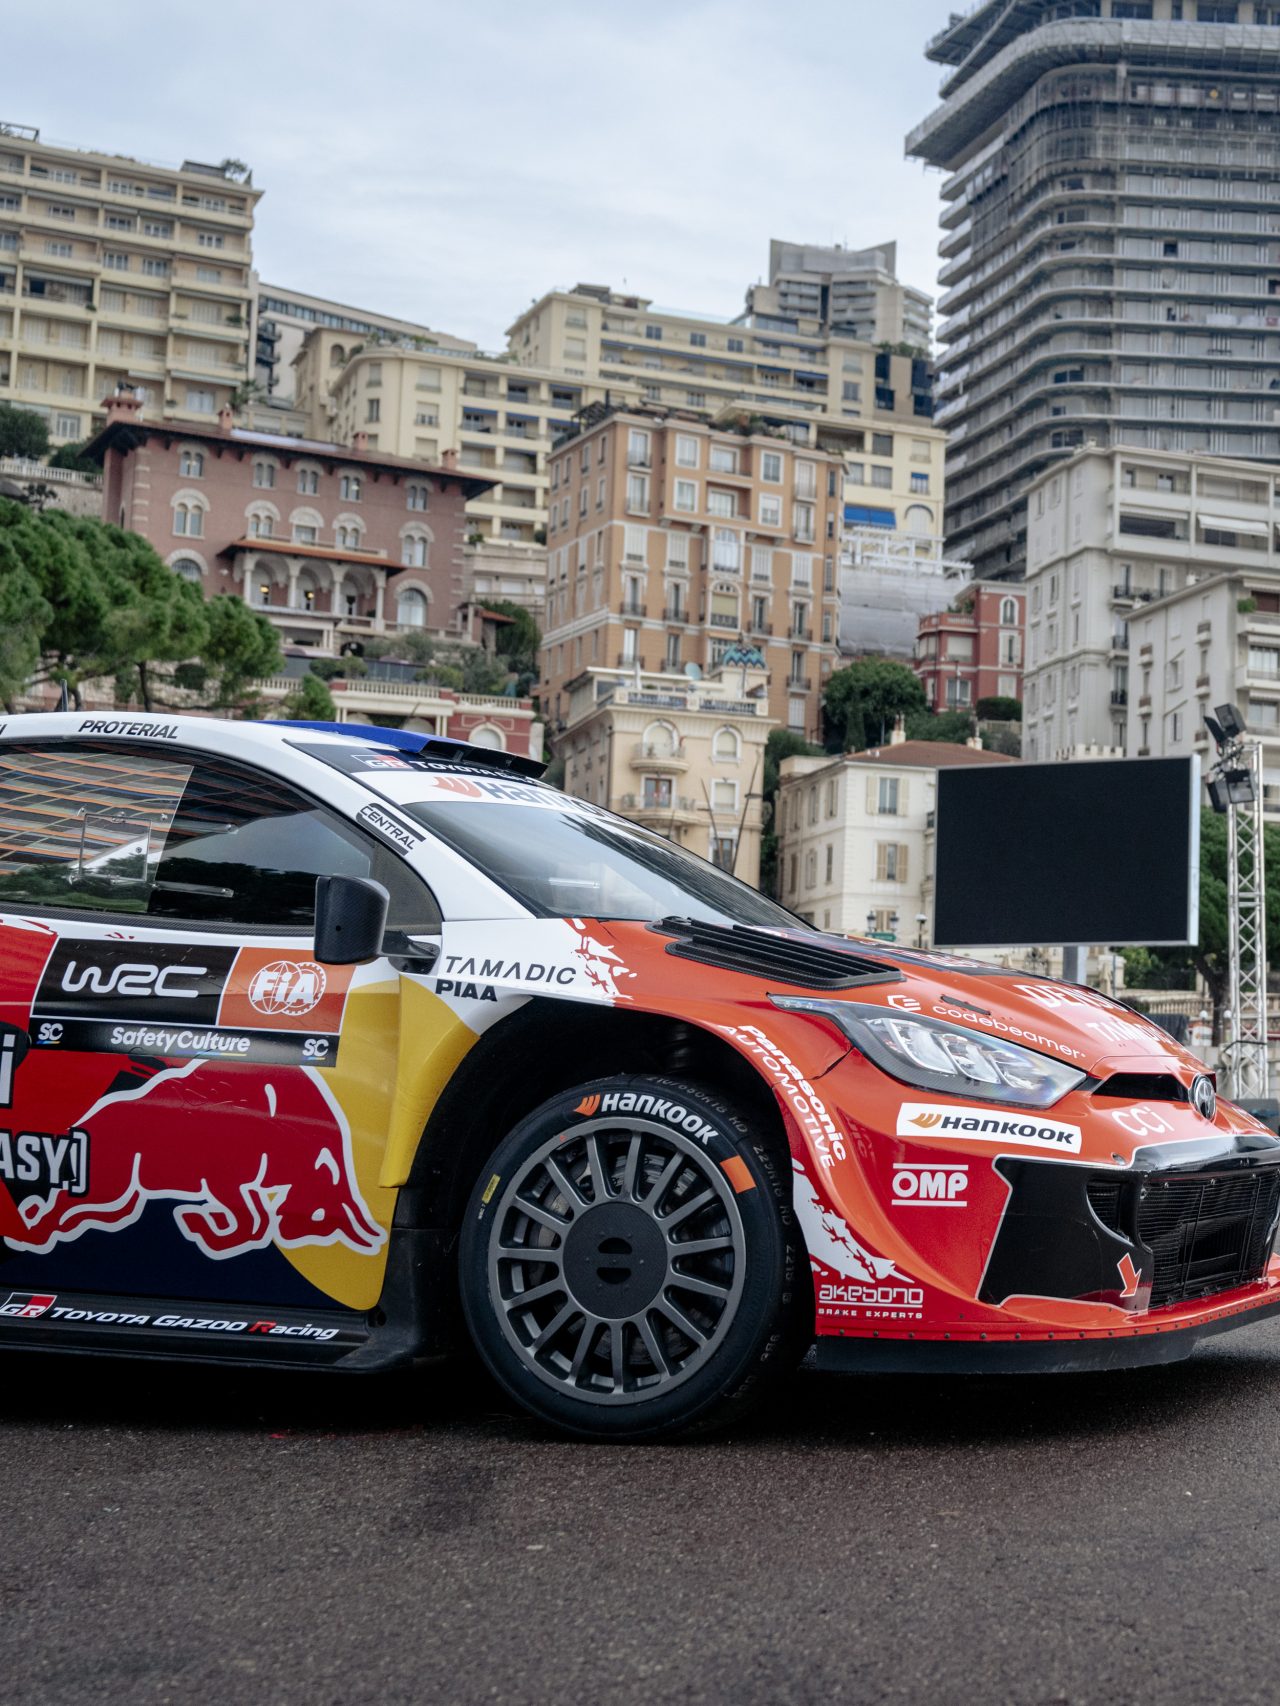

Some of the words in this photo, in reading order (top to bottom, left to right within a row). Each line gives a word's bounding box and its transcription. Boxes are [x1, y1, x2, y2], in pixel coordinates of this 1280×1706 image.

[78, 719, 180, 739] PROTERIAL
[360, 805, 414, 850] CENTRAL
[61, 960, 208, 998] WRC
[445, 955, 577, 985] TAMADIC
[435, 978, 498, 1002] PIAA
[38, 1022, 64, 1041] SC
[110, 1026, 251, 1053] SafetyCulture
[932, 1005, 1080, 1059] codebeamer
[303, 1038, 329, 1057] SC
[718, 1025, 836, 1169] AUTOMOTIVE
[738, 1025, 847, 1161] Panasonic
[892, 1170, 969, 1200] OMP
[0, 1303, 46, 1317] GR
[51, 1306, 150, 1326] TOYOTA
[152, 1314, 249, 1332] GAZOO
[249, 1320, 340, 1341] Racing
[818, 1307, 858, 1317] BRAKE
[866, 1310, 923, 1319] EXPERTS
